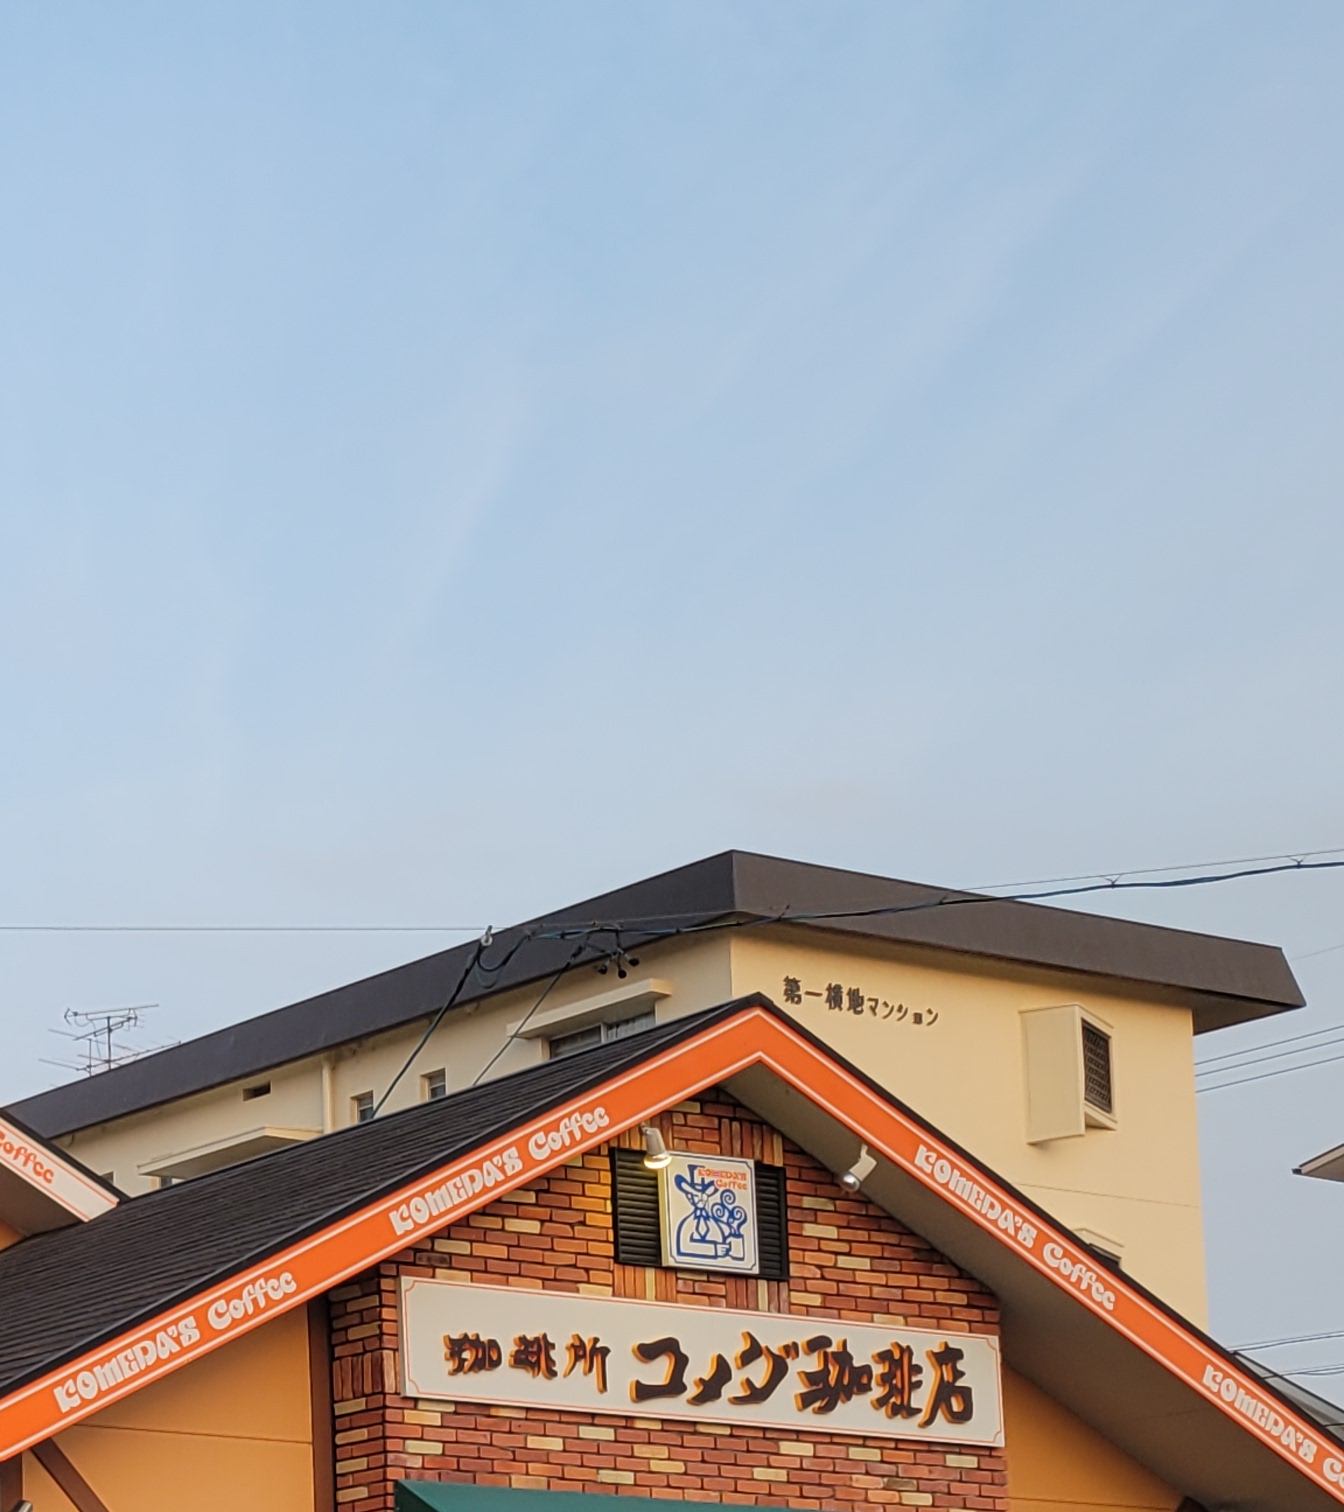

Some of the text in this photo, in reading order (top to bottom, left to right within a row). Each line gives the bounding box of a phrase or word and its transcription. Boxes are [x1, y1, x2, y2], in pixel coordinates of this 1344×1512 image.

[783, 975, 939, 1026] 第一横地マンション
[388, 1106, 610, 1236] KOMEDA'S Coffee
[914, 1144, 1116, 1311] KOMEDA'S Coffee
[53, 1271, 297, 1413] KOMEDA'S Coffee
[442, 1330, 975, 1429] 珈琲所 コメダ珈琲店
[1202, 1364, 1318, 1464] KOMEDA'S
